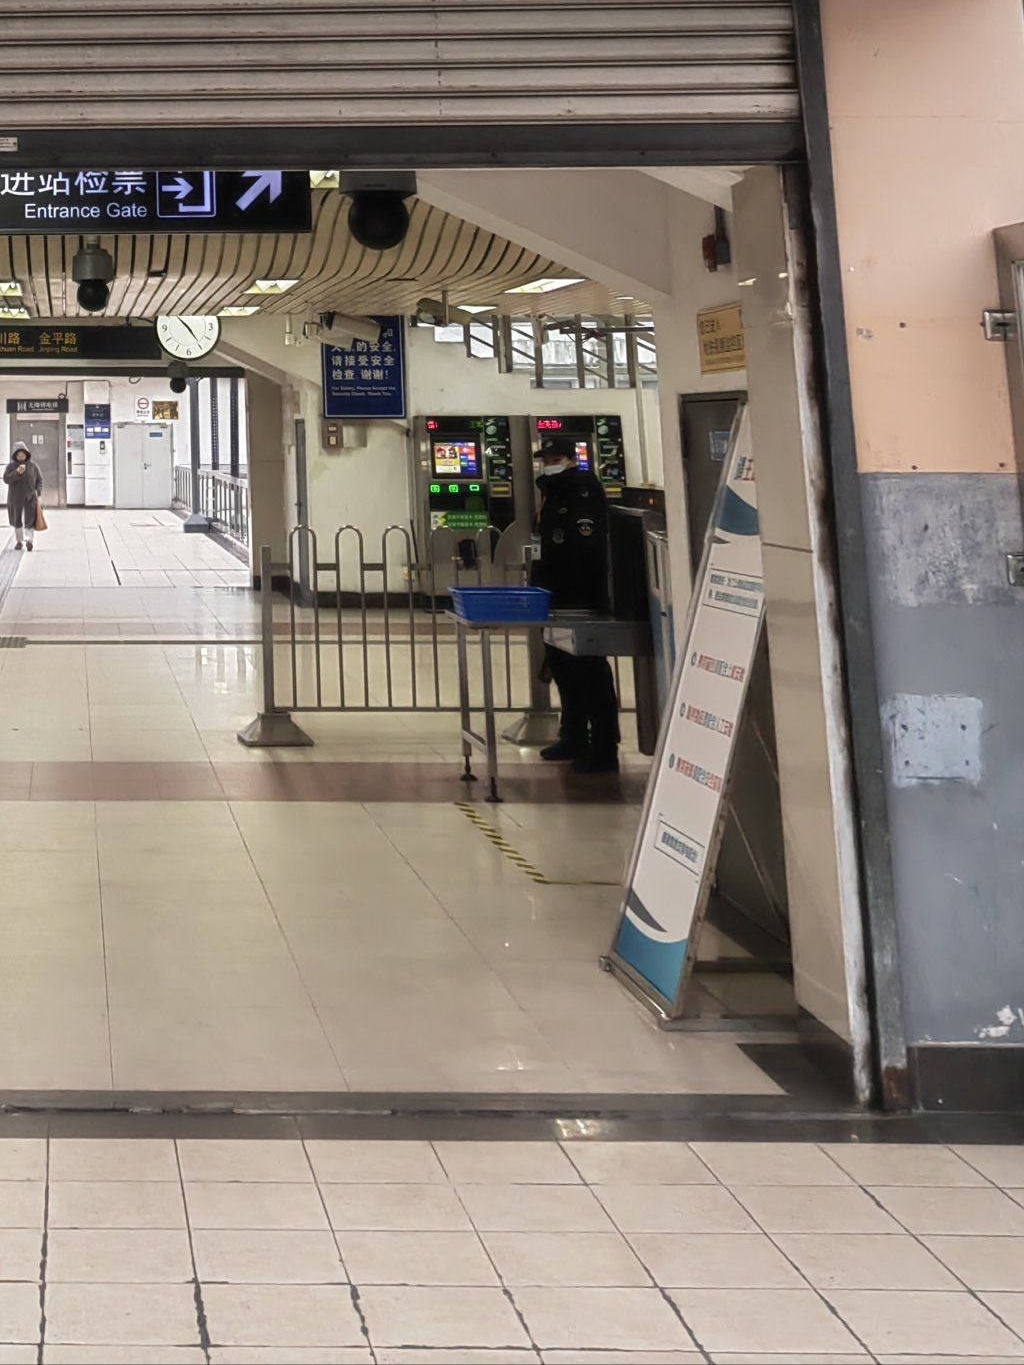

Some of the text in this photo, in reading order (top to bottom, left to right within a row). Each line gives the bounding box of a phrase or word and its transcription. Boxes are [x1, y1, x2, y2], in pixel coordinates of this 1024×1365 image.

[0, 170, 148, 196] 进站检票
[24, 202, 148, 219] Entrance Gate
[162, 324, 168, 332] 9
[208, 322, 214, 331] 3
[38, 331, 77, 345] 金平路
[186, 348, 192, 356] 6
[331, 355, 396, 367] 请接受安全
